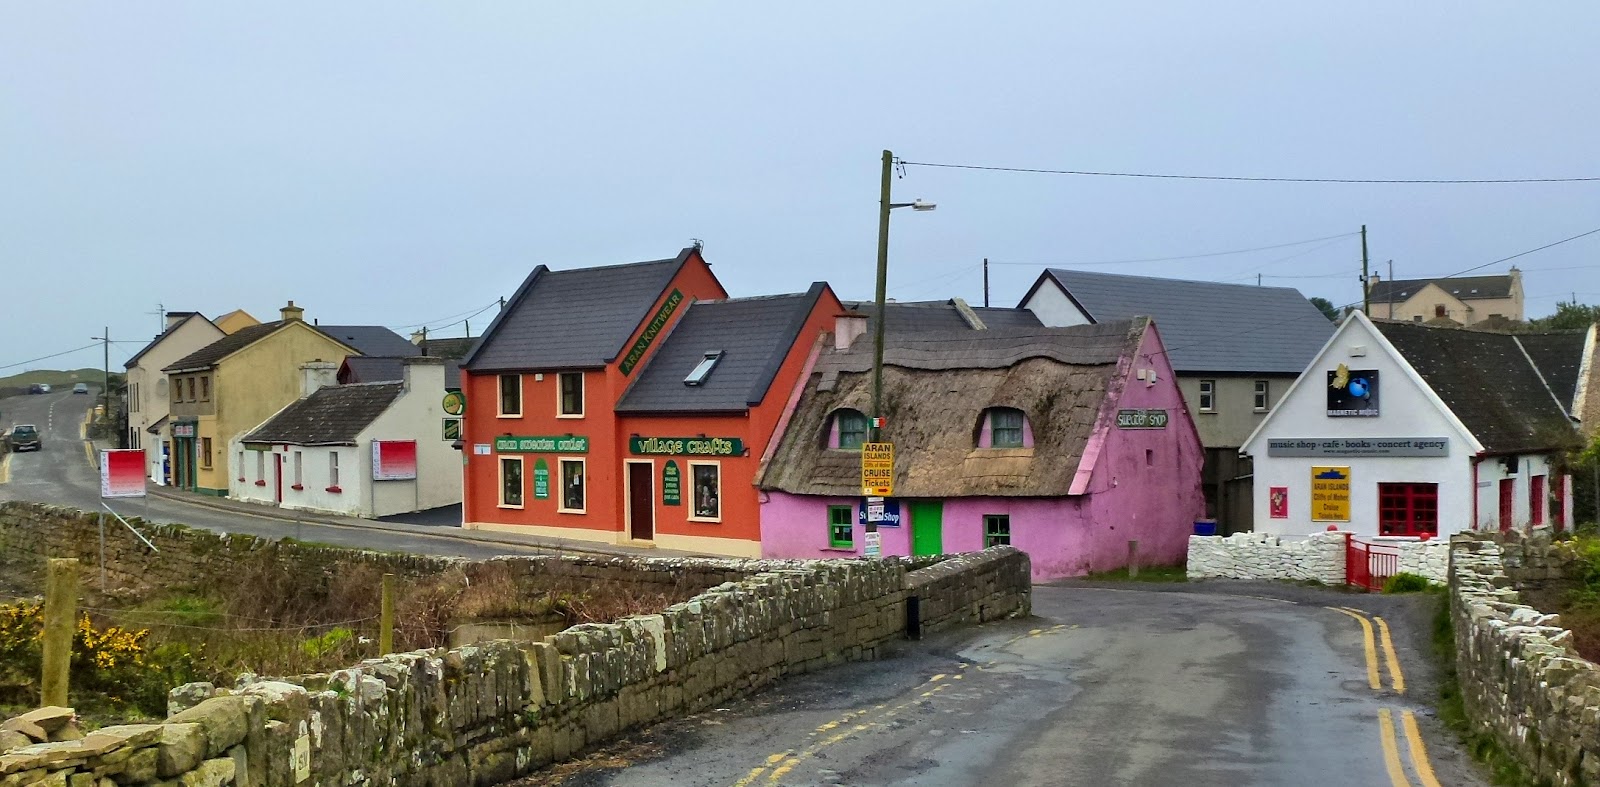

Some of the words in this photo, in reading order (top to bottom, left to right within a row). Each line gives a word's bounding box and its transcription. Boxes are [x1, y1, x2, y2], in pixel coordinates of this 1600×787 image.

[624, 343, 646, 371] ARAN
[642, 294, 680, 343] KNITWEAR
[1297, 441, 1316, 450] shop
[1414, 442, 1445, 450] agency
[884, 512, 899, 523] Shop
